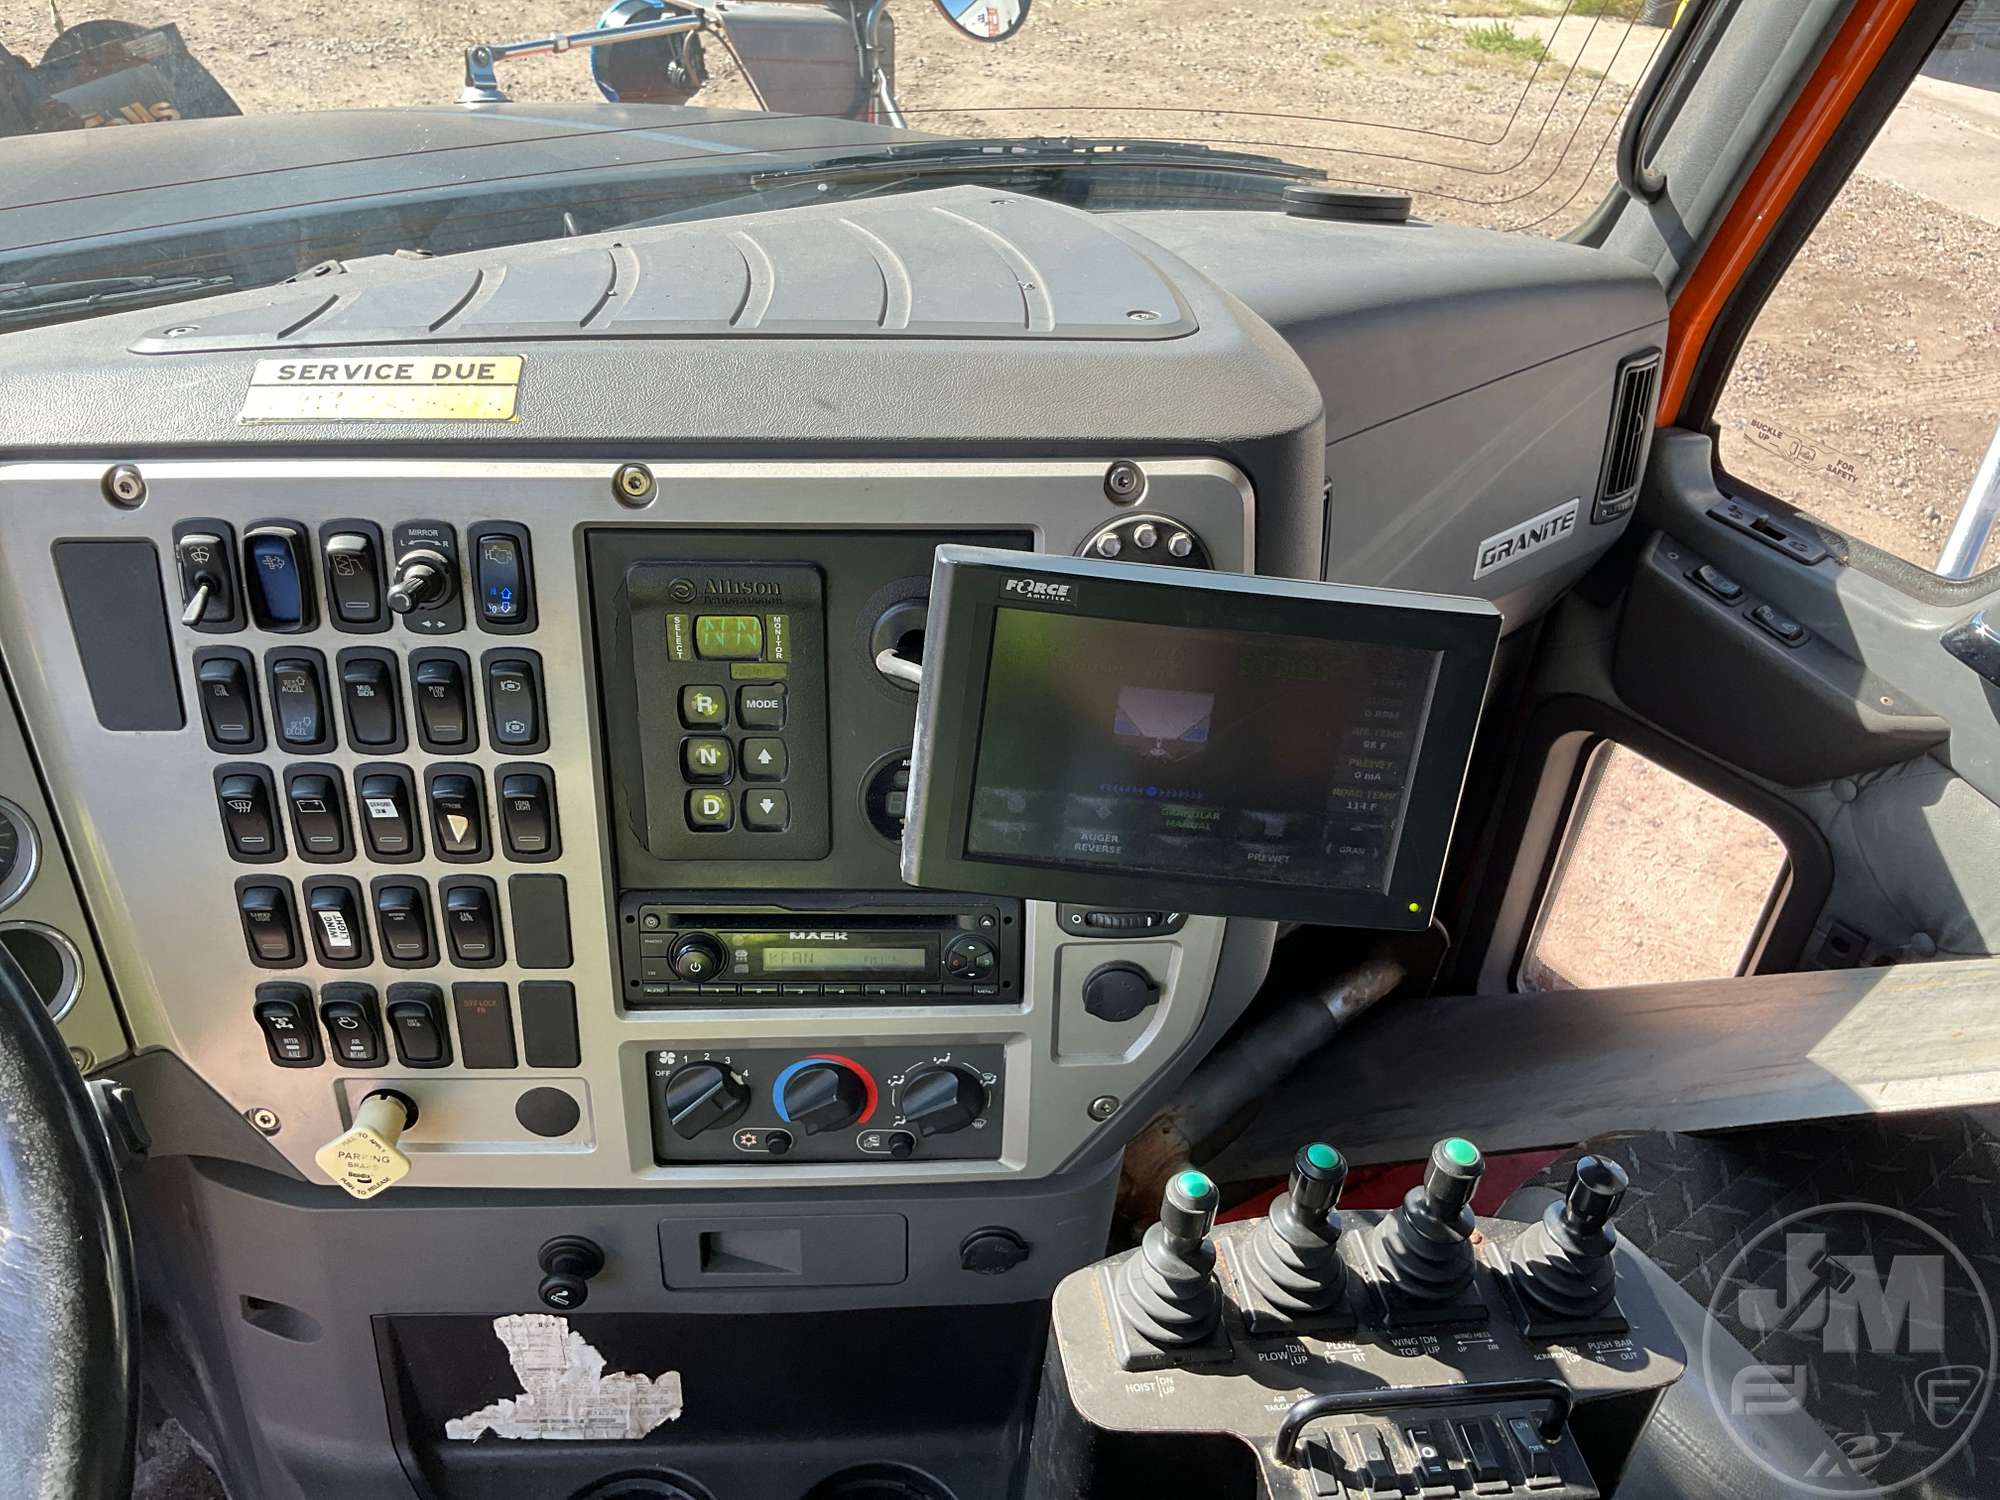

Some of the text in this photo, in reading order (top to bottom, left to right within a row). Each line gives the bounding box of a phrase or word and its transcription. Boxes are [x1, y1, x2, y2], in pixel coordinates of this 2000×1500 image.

[277, 363, 496, 381] SERVICE DUE
[1751, 420, 1783, 439] BUCKLE
[1758, 431, 1770, 441] UP
[1836, 459, 1855, 473] FOR
[1825, 463, 1858, 483] SAFETY
[408, 528, 439, 537] MIRROR
[442, 540, 449, 548] R
[704, 578, 782, 595] Allison
[1005, 578, 1071, 598] FORCE
[673, 616, 684, 659] SELECT
[773, 616, 784, 660] MONITOR
[697, 695, 713, 713] R
[746, 699, 779, 709] MODE
[700, 749, 716, 764] N
[703, 799, 720, 815] D
[1080, 833, 1119, 843] AUGER
[1073, 843, 1123, 854] REVERSE
[1247, 852, 1291, 864] PREWET
[324, 915, 339, 939] WING
[333, 914, 350, 940] LIGHT
[789, 932, 849, 940] MACK
[704, 1053, 710, 1061] 2
[725, 1056, 731, 1064] 3
[742, 1069, 749, 1077] 4
[1391, 1337, 1419, 1347] WING
[1423, 1336, 1437, 1344] DN
[1587, 1339, 1634, 1351] PUSH BAR
[1289, 1345, 1306, 1354] DN
[1399, 1347, 1418, 1357] TOE
[1427, 1345, 1440, 1354] UP
[1258, 1351, 1288, 1362] PLOW
[1293, 1355, 1308, 1365] UP
[1619, 1352, 1638, 1361] OUT
[1159, 1376, 1174, 1385] DN
[1125, 1382, 1156, 1393] HOIST
[1162, 1385, 1176, 1395] UP
